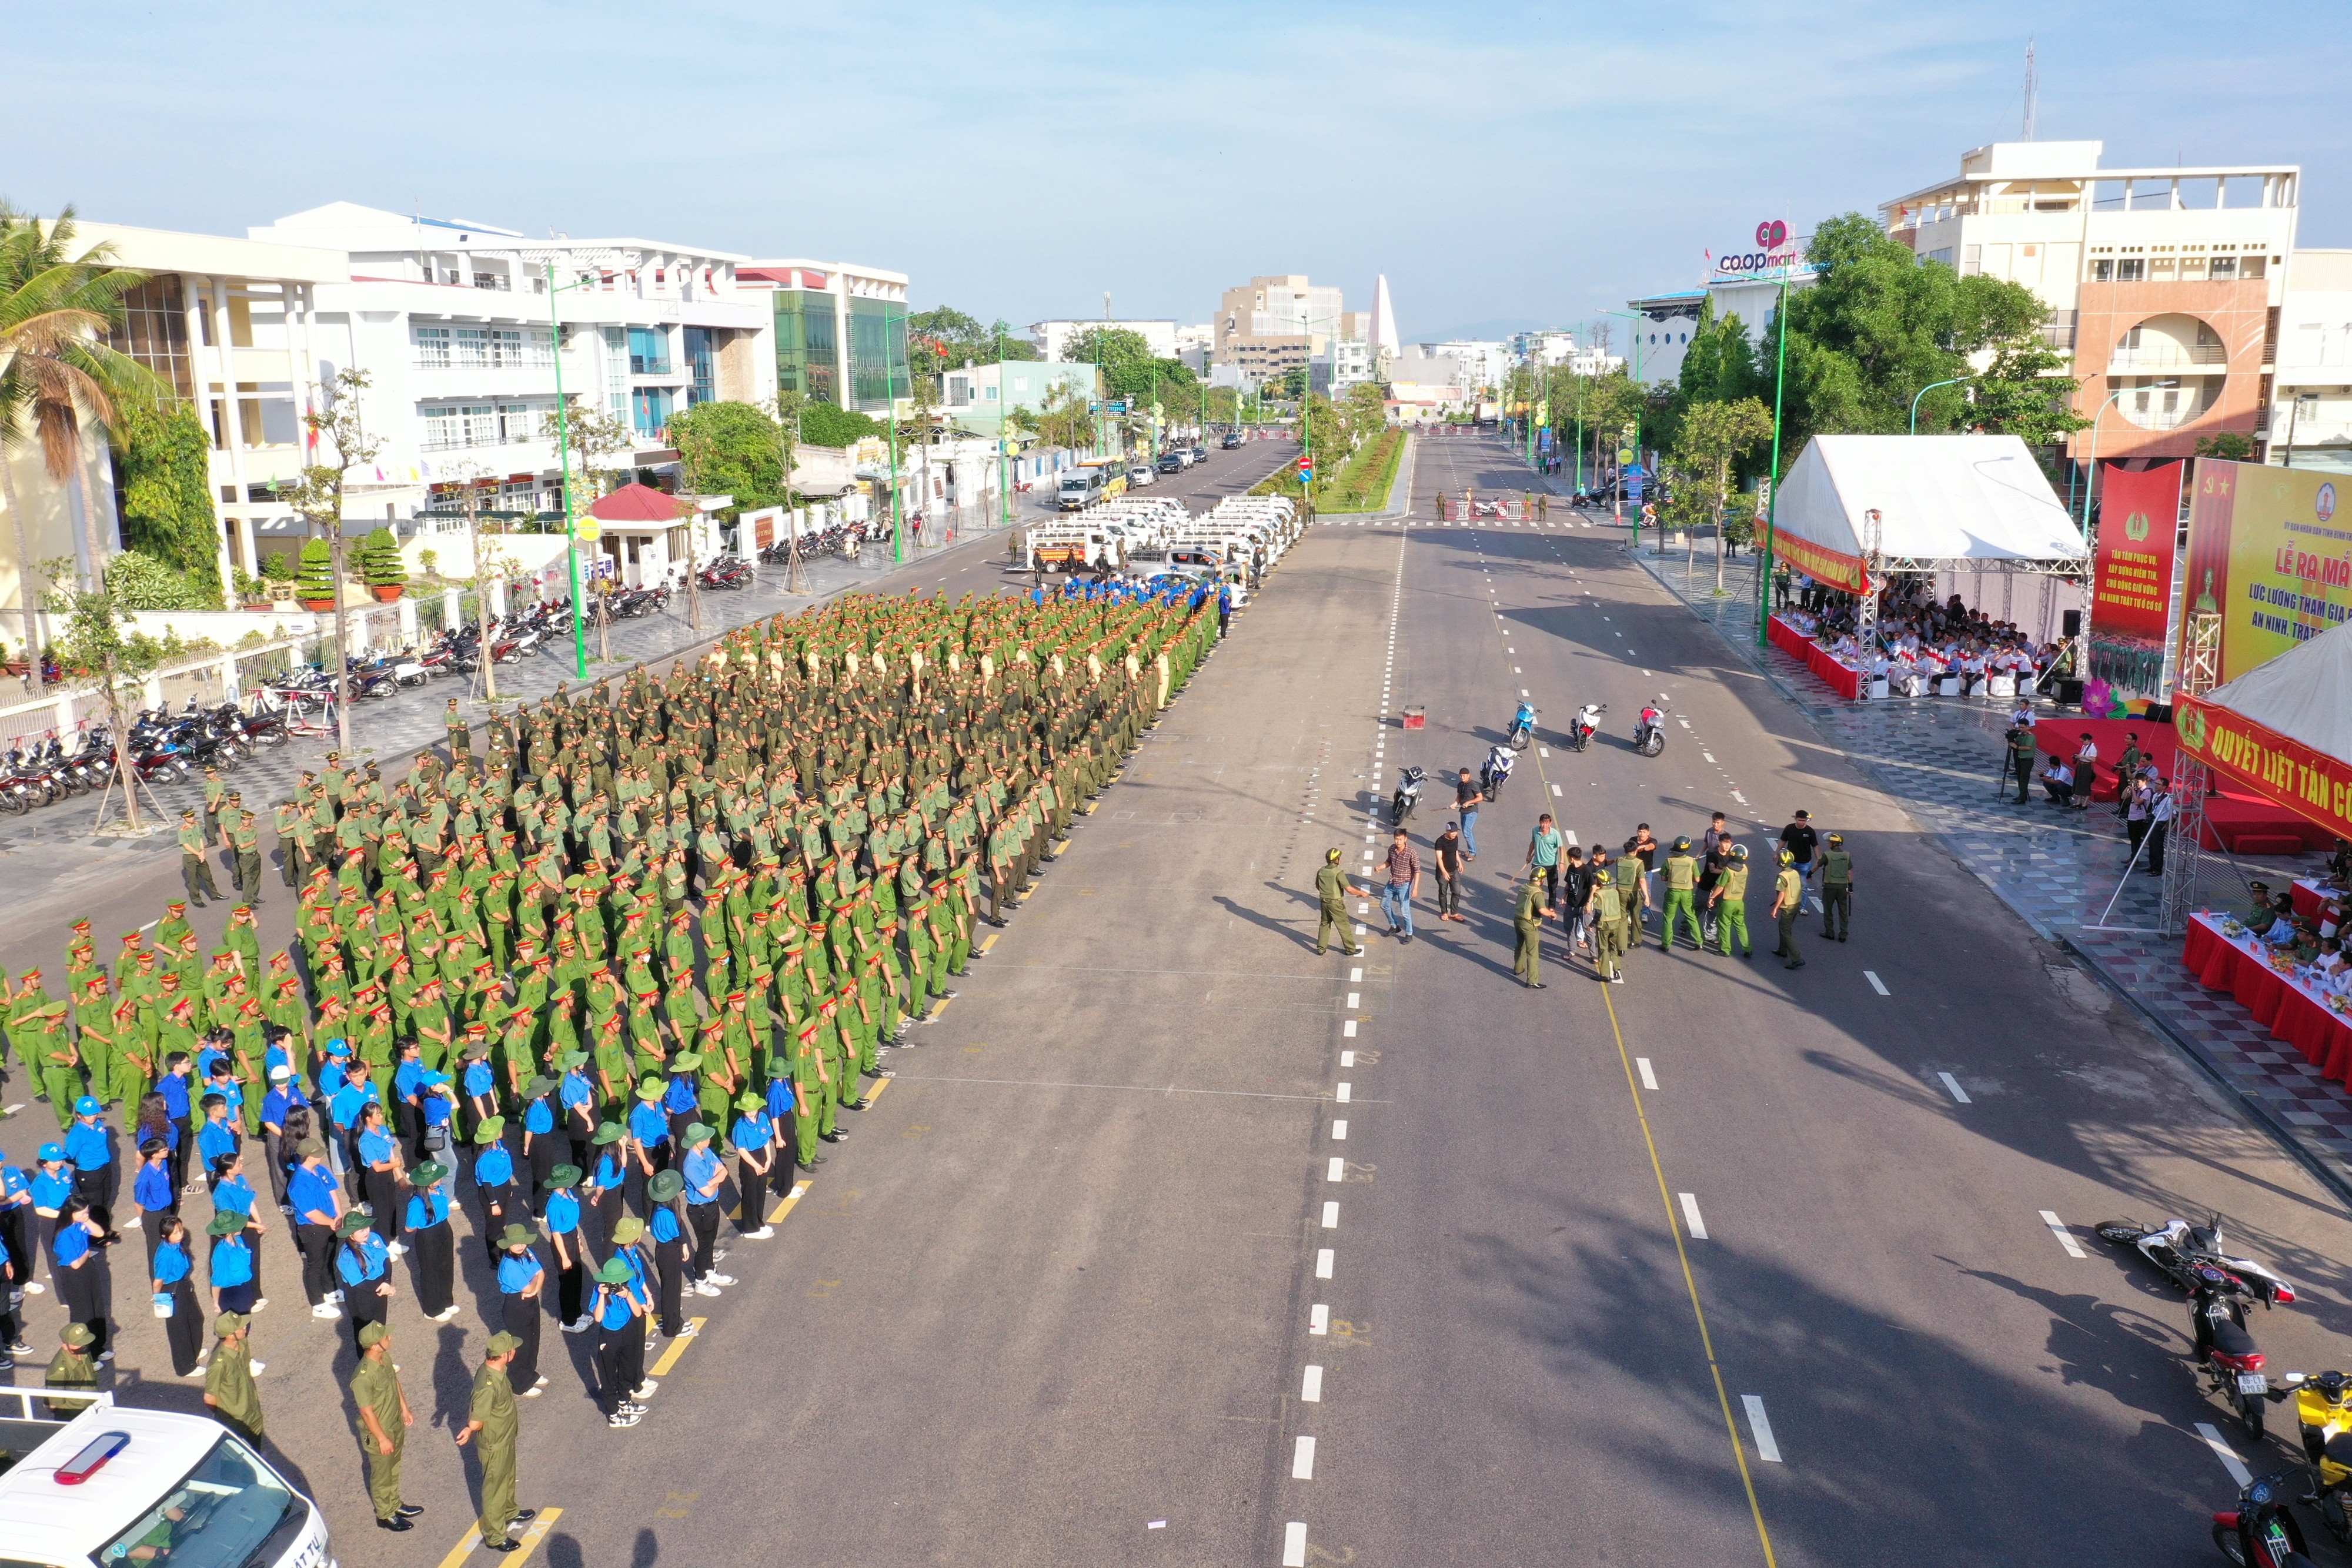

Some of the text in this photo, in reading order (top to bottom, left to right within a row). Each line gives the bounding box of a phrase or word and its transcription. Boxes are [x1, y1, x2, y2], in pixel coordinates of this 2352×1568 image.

[2112, 549, 2121, 561] TẬN
[2122, 550, 2133, 561] TÂM
[2133, 552, 2148, 564] PHỤC
[2274, 539, 2352, 589] LỄ RA MẮ
[2107, 563, 2118, 574] XÂY
[2118, 565, 2133, 577] DỰNG
[2106, 577, 2117, 589] CHỦ
[2143, 584, 2157, 596] VỮNG
[2099, 591, 2106, 601] AN
[2106, 593, 2120, 604] NINH
[2120, 595, 2133, 608] TRẬT
[2249, 583, 2266, 602] LỰC
[2267, 587, 2297, 610] LƯỢNG
[2299, 594, 2326, 618] THAM
[2327, 603, 2345, 624] GIA
[2251, 611, 2264, 628] AN
[2265, 614, 2289, 637] NINH,
[2211, 726, 2352, 824] QUYẾT LIỆT TẤN CÔ
